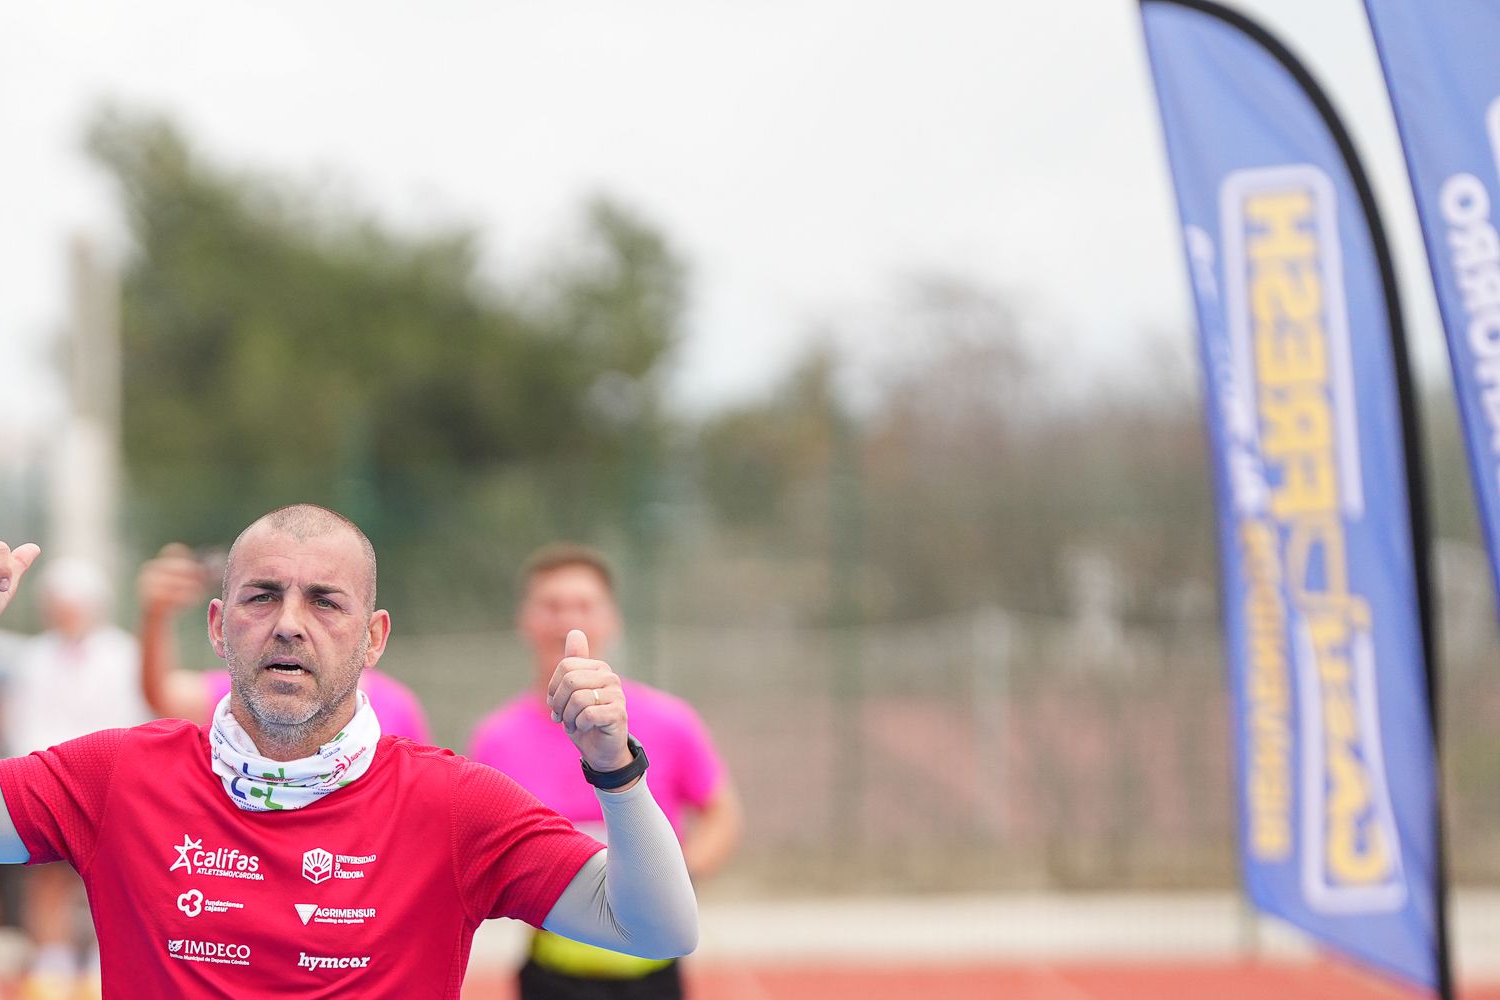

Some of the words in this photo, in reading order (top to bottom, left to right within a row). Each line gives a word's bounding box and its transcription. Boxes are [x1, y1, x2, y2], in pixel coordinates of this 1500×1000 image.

[193, 847, 259, 872] califas
[335, 854, 377, 864] UNIVERSIDAD
[334, 869, 365, 879] CÓRDOBA
[205, 899, 244, 908] fundaciones
[314, 907, 376, 918] AGRIMENSUR
[185, 939, 251, 959] IMDECO
[297, 952, 370, 971] hymcor
